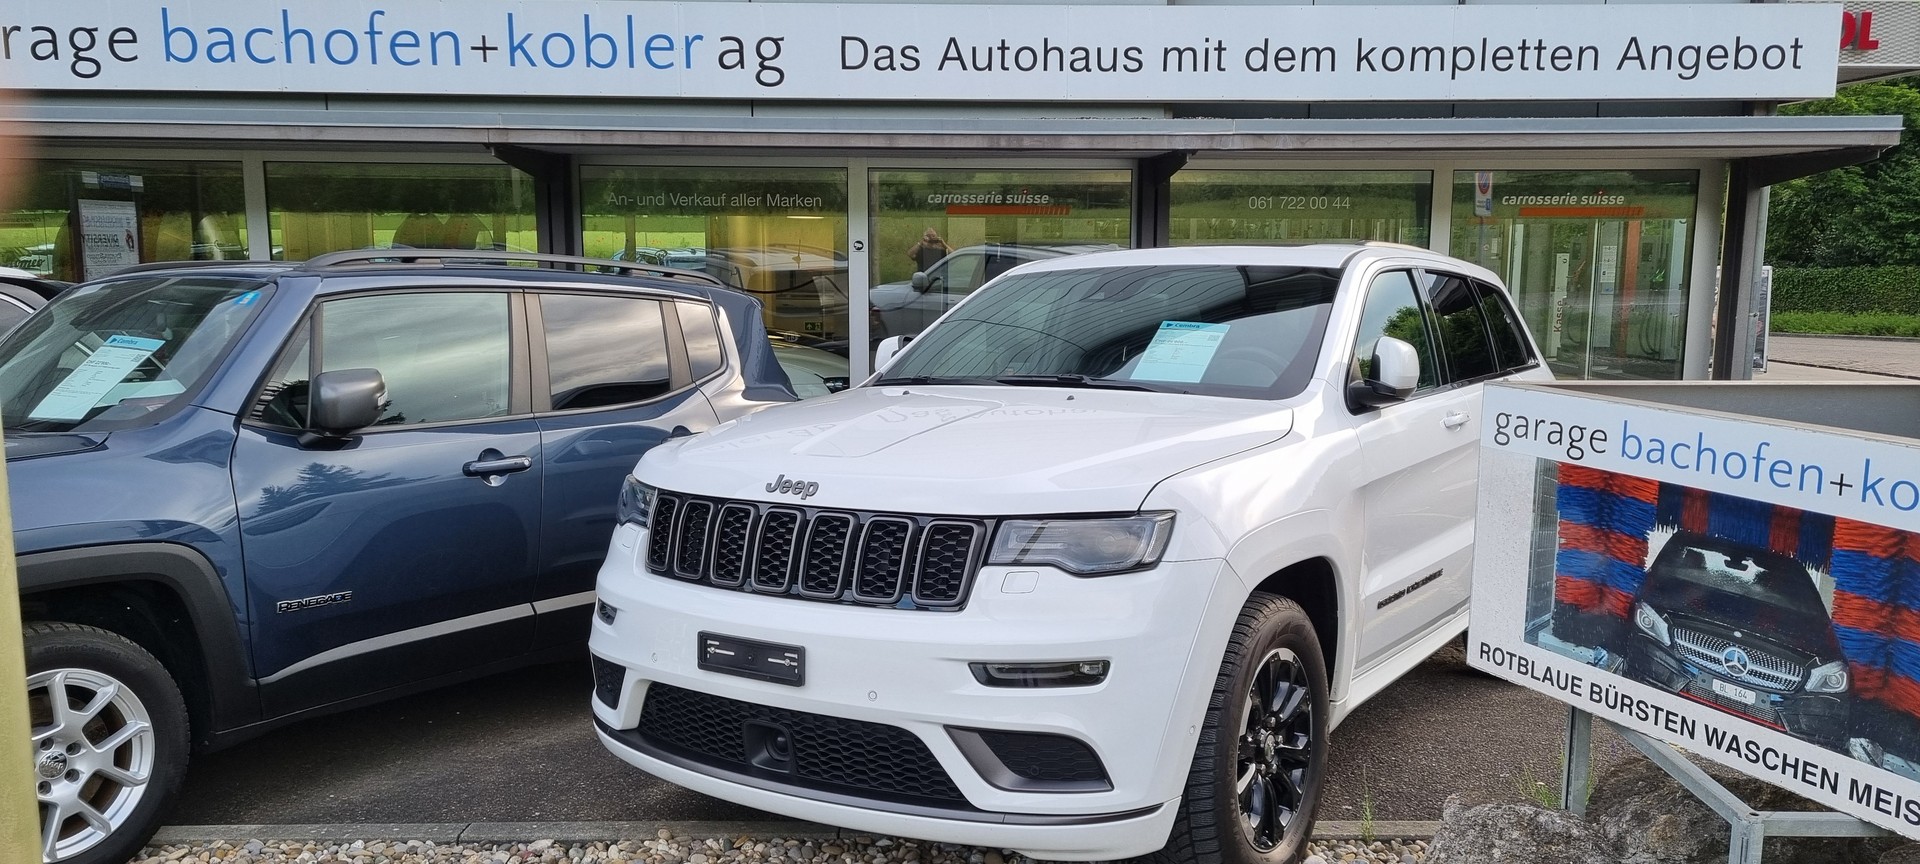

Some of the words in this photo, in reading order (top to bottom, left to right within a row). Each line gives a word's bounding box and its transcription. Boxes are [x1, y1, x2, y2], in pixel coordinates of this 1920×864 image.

[2, 25, 138, 78] rage
[717, 35, 785, 87] ag
[840, 36, 921, 71] Das
[938, 37, 1144, 72] Autohaus
[1162, 38, 1227, 72] mit
[1245, 38, 1336, 72] dem
[1356, 37, 1599, 80] kompletten
[1616, 36, 1804, 80] Angebot
[607, 193, 634, 206] An-
[637, 193, 665, 206] und
[669, 193, 726, 207] Verkauf
[730, 194, 762, 207] aller
[766, 194, 822, 207] Marken
[927, 191, 1003, 204] carrosserie
[1006, 190, 1049, 204] suisse
[1248, 196, 1273, 209] 061
[1280, 196, 1306, 209] 722
[1309, 196, 1328, 209] 00
[1332, 196, 1351, 209] 44
[1501, 192, 1578, 205] carrosserie
[1580, 191, 1625, 205] suisse
[1553, 300, 1564, 333] Kasse
[1494, 412, 1608, 460] garage
[765, 474, 819, 500] Jeep
[277, 590, 353, 614] RENEGADE
[1734, 688, 1748, 699] 164
[1479, 641, 1583, 698] ROTBLAUE
[1589, 682, 1696, 740] BÜRSTEN
[1704, 724, 1840, 795] WASCHEN
[1849, 778, 1920, 826] MEIS
